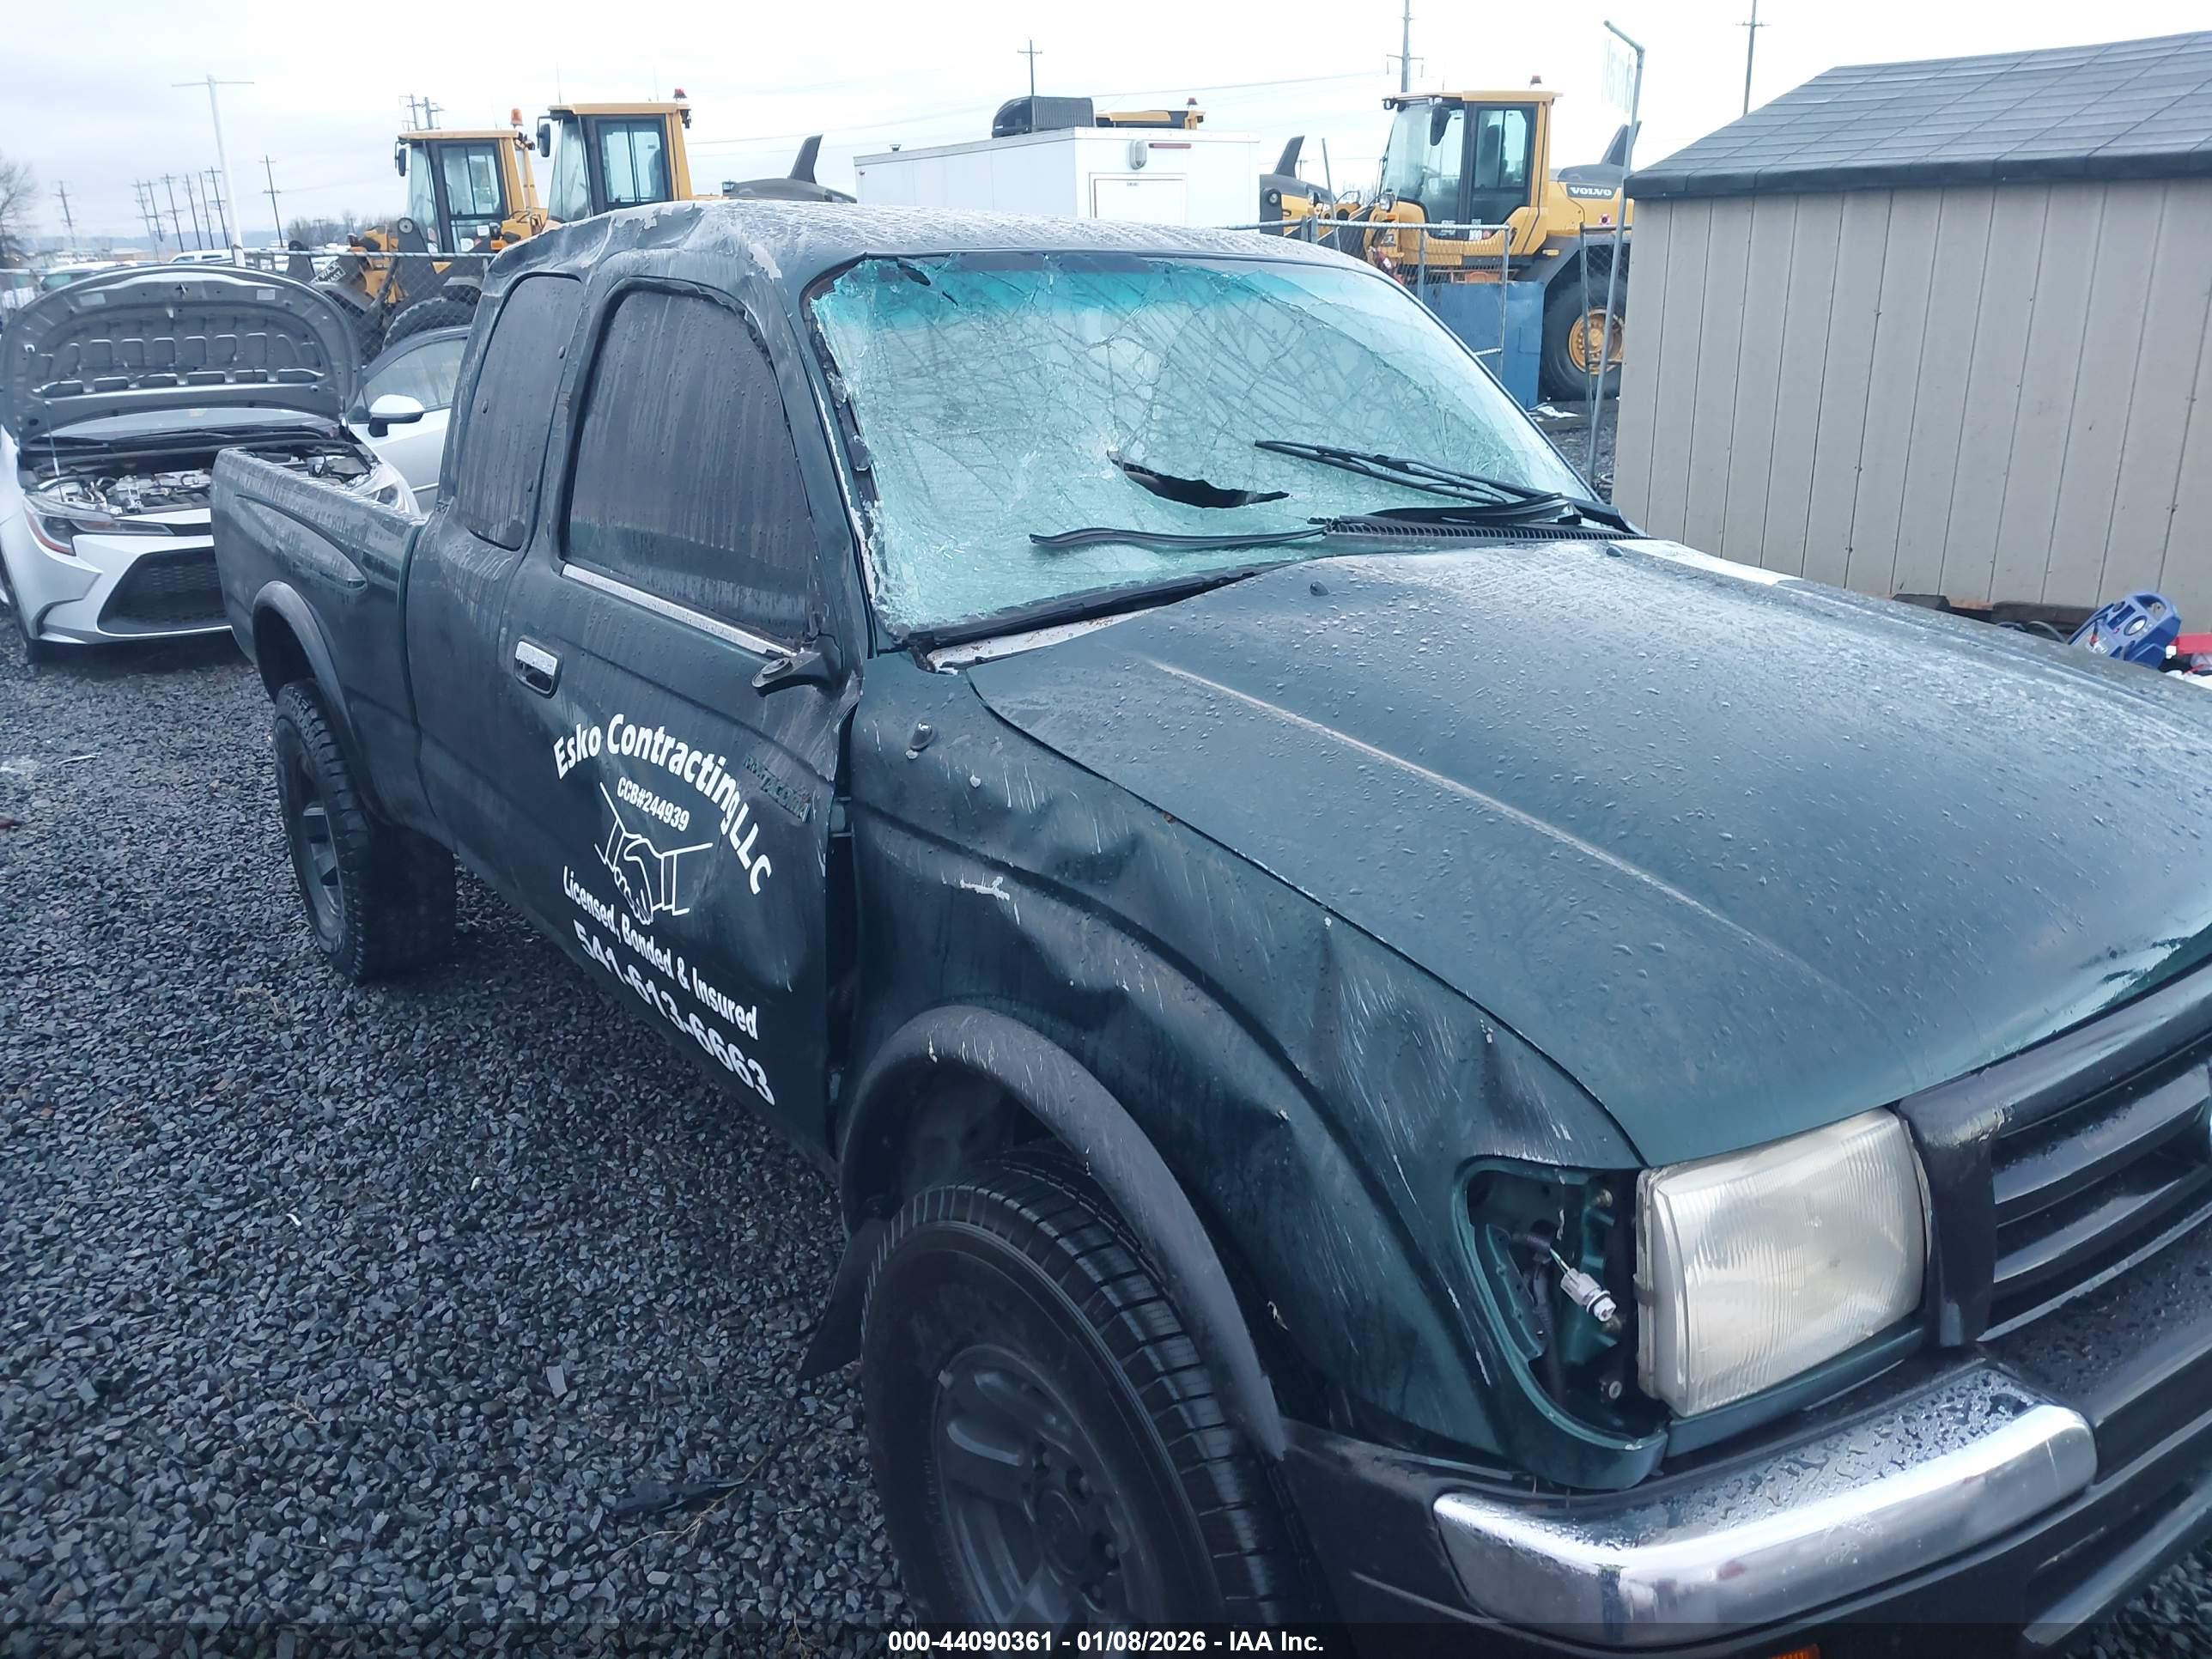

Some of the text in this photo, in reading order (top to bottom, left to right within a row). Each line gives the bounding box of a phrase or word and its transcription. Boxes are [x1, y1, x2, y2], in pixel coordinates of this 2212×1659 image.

[1570, 186, 1612, 197] VOLVO
[553, 713, 772, 896] Esko Contracting LLC
[617, 775, 690, 832] CCB#244939
[573, 919, 775, 1106] 541-613-6663
[621, 912, 675, 981] Bonded
[677, 956, 691, 992] &
[692, 966, 759, 1041] Insured
